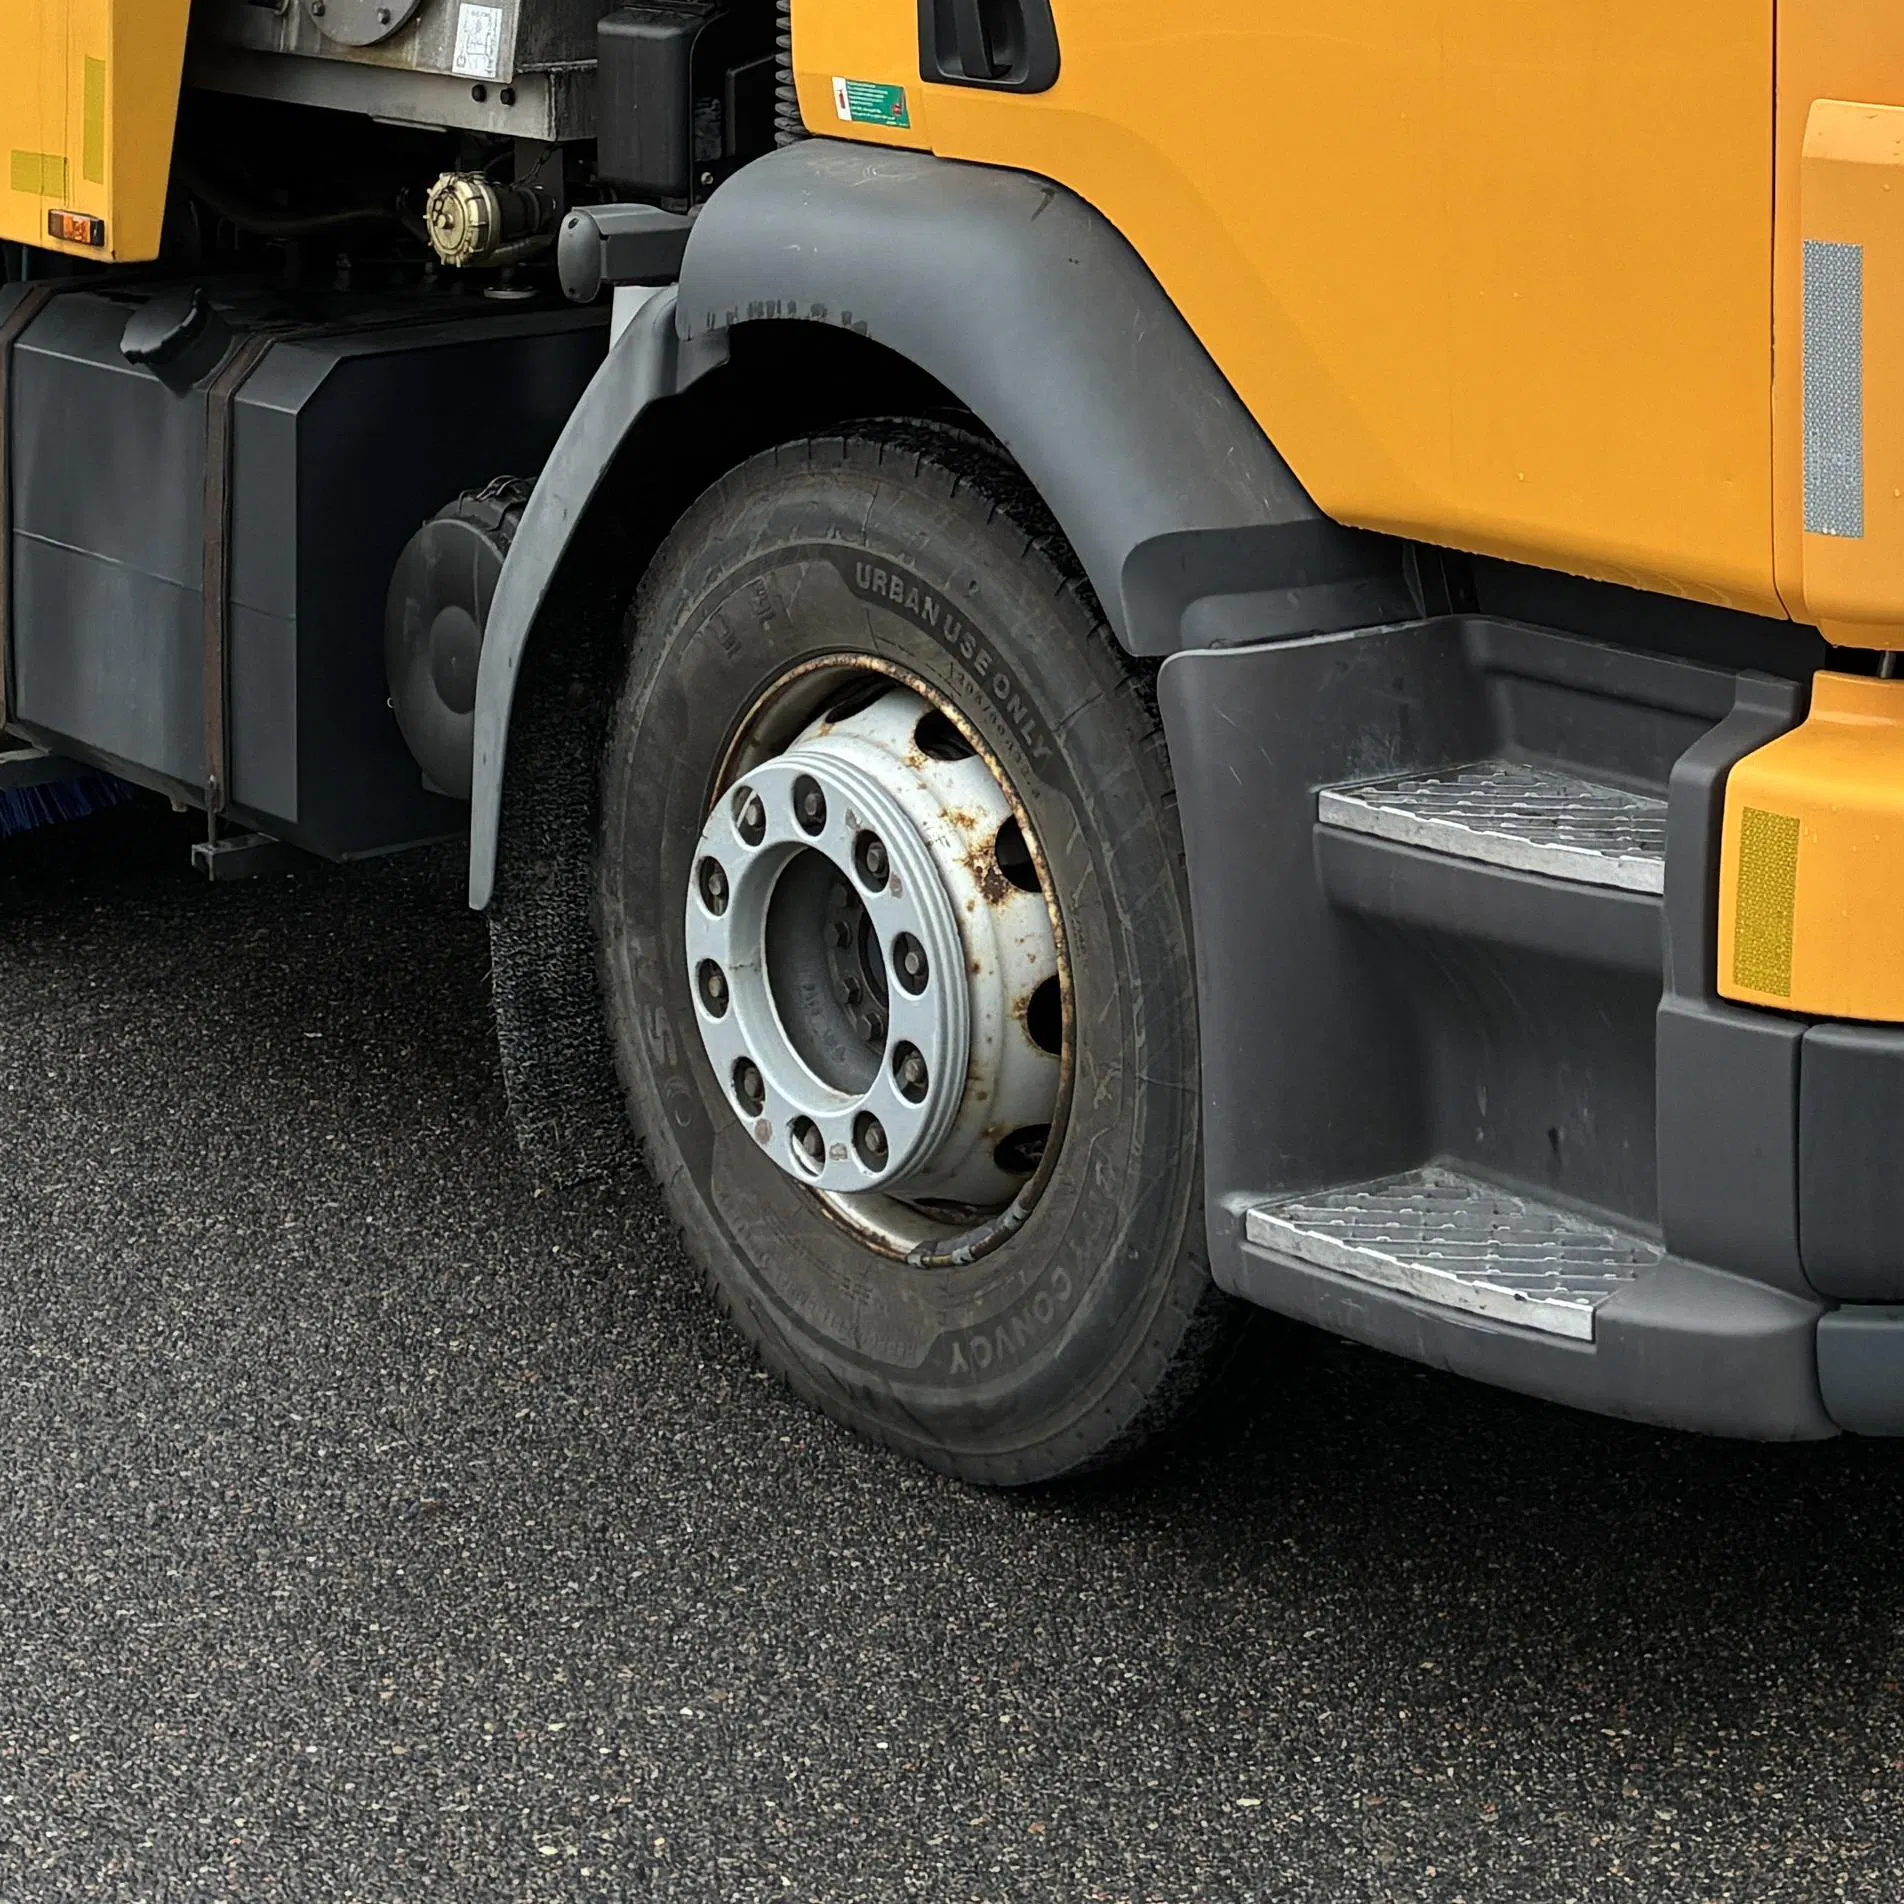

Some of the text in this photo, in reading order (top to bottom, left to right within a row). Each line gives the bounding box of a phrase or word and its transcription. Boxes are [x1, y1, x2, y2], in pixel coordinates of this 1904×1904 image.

[855, 561, 941, 627] URBAN
[943, 613, 993, 677] USE
[992, 673, 1053, 758] ONLY
[946, 1264, 1074, 1375] CONVOY
